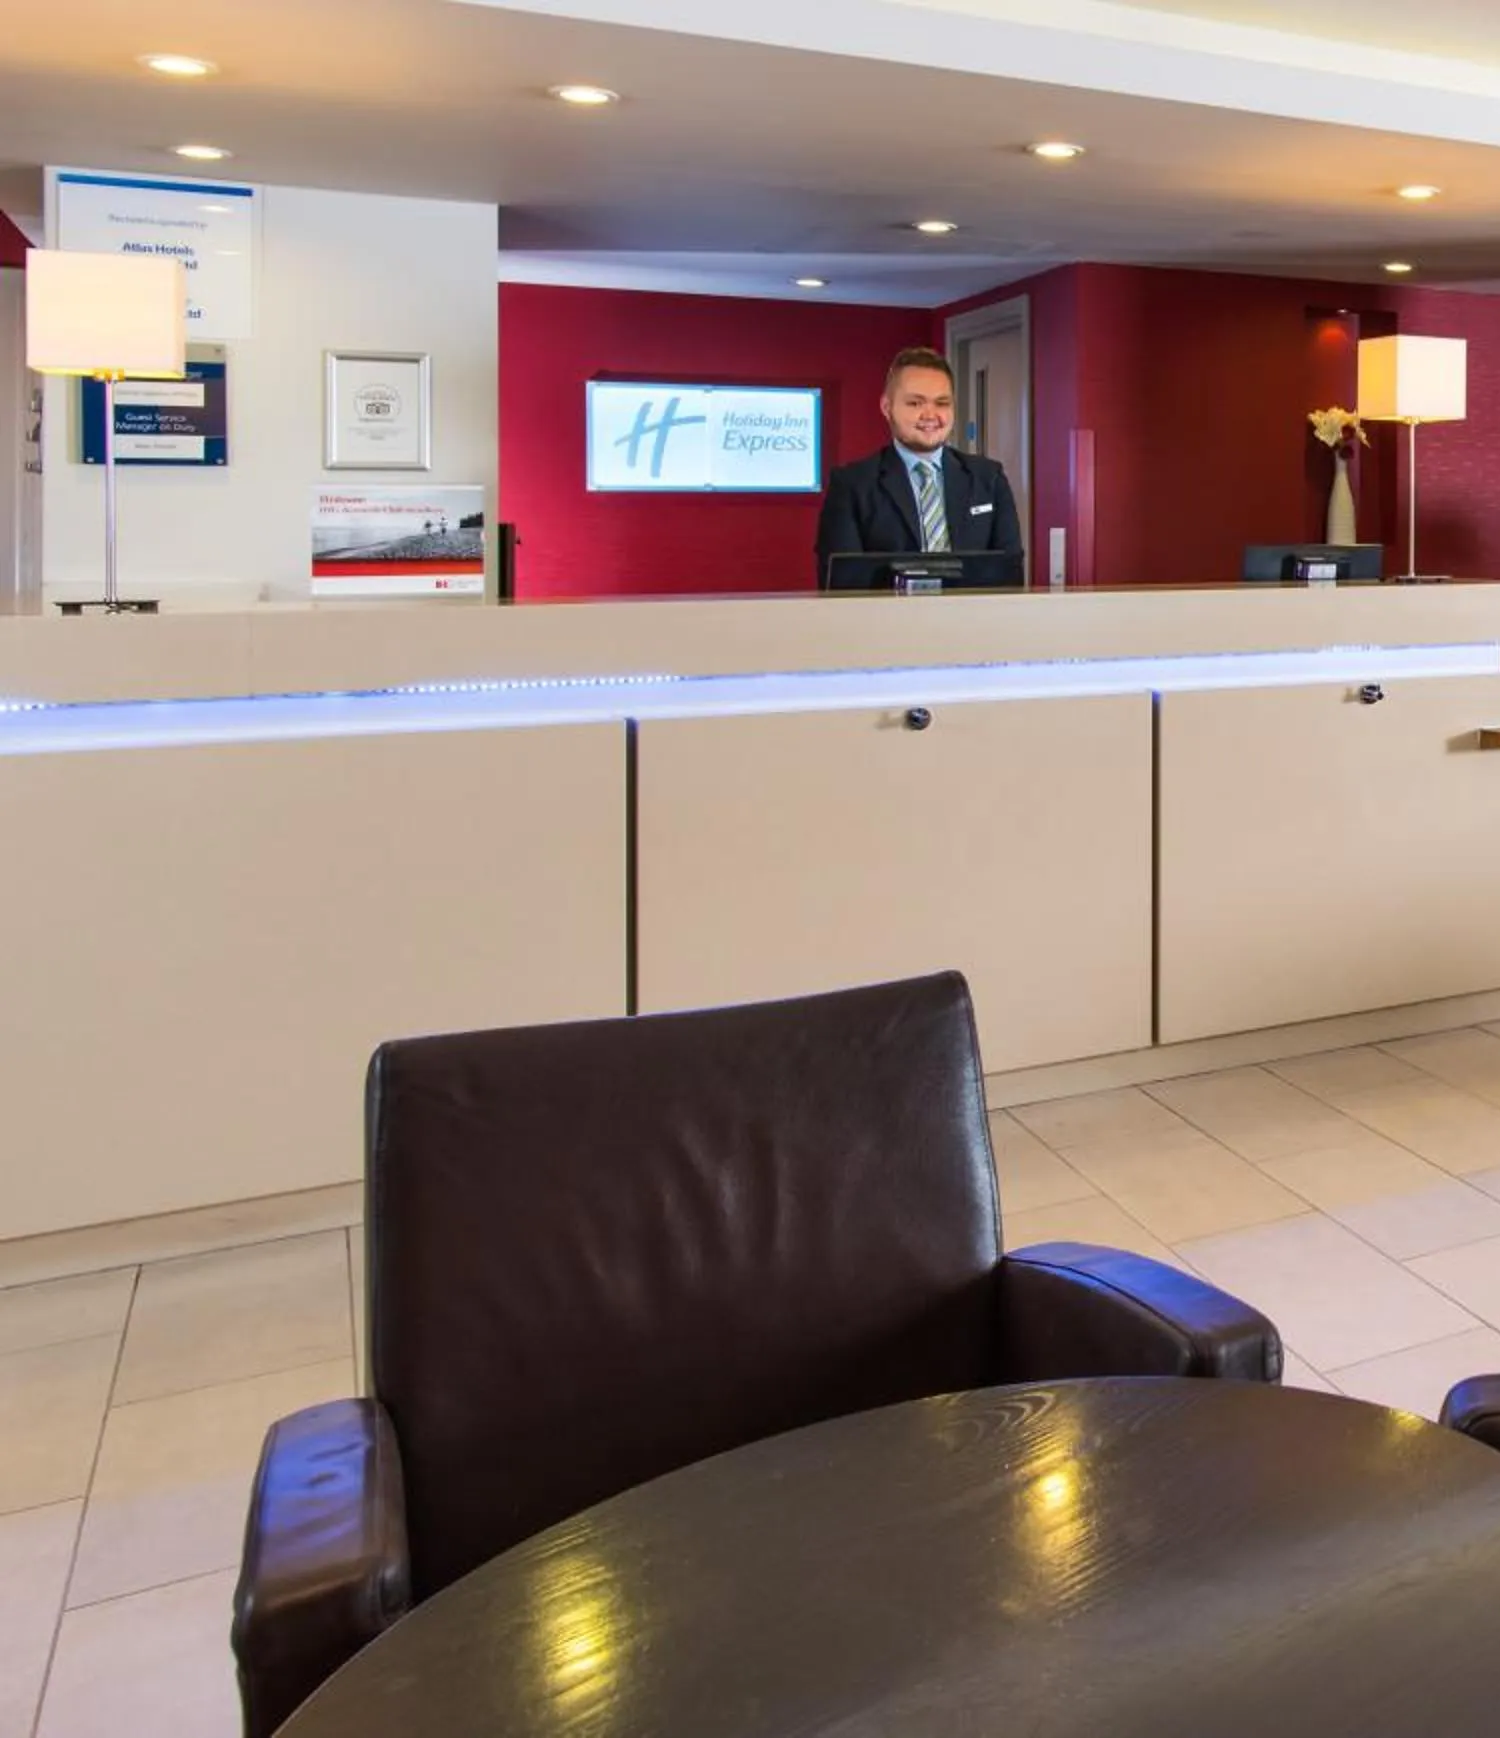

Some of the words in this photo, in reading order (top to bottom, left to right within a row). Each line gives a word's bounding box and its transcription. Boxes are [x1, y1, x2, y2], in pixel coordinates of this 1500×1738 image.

[114, 421, 158, 432] Manager
[173, 423, 197, 432] Duty
[722, 411, 784, 430] Holiday
[784, 412, 809, 428] Inn
[722, 430, 809, 455] Express
